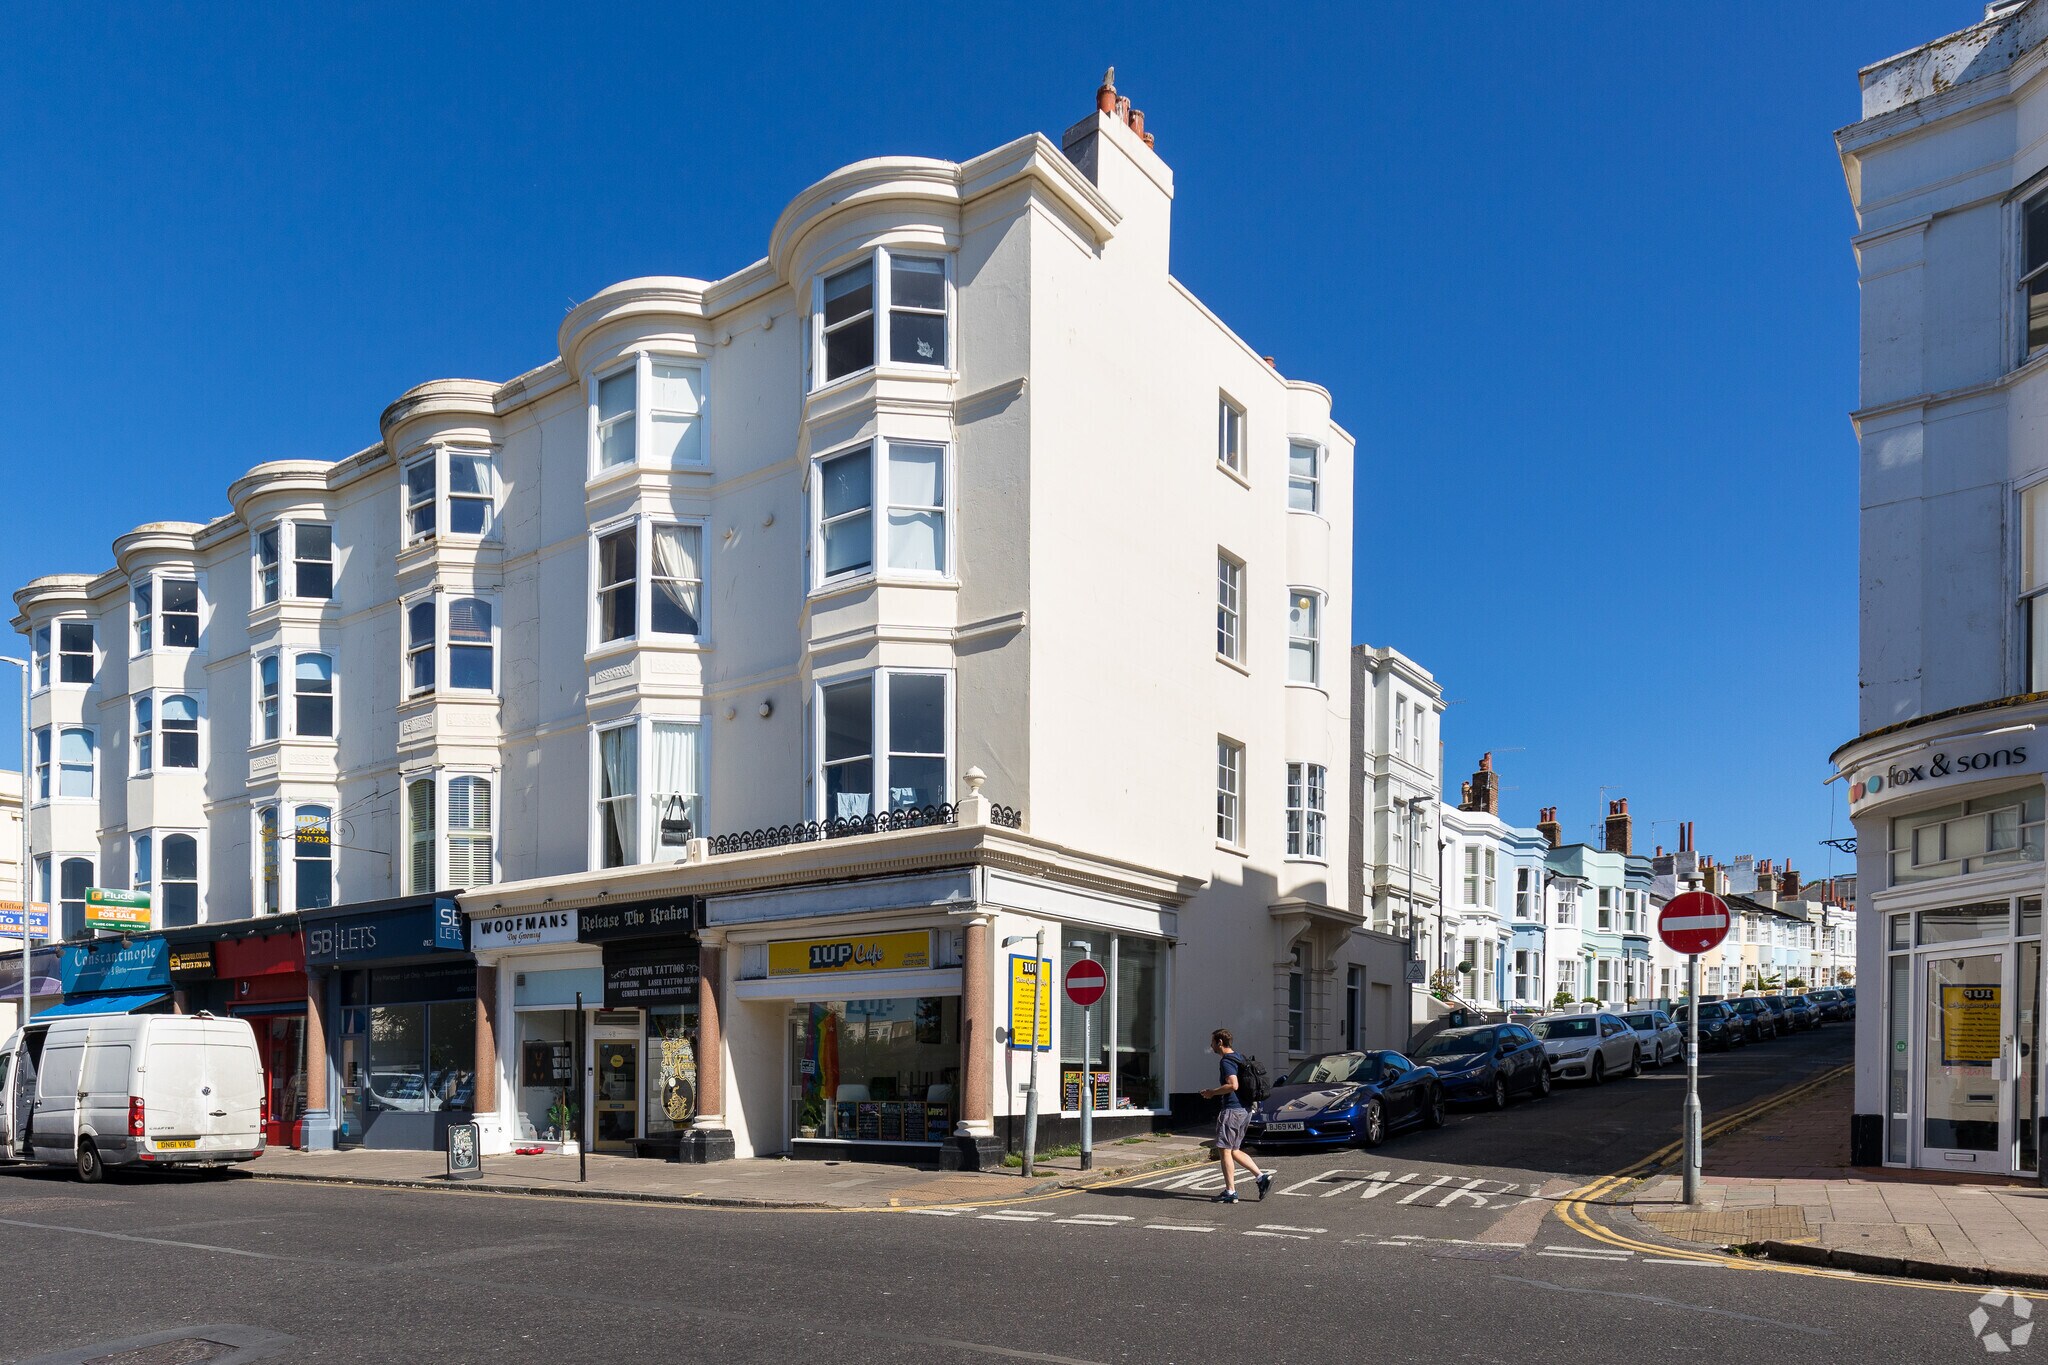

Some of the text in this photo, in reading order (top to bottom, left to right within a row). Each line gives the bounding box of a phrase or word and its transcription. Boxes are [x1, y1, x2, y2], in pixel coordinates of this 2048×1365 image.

[1886, 746, 2027, 789] fox & sons
[0, 915, 14, 924] To
[481, 913, 568, 934] WOOFMANS
[581, 906, 689, 932] Release The Kraken
[310, 925, 376, 954] SB LETS
[439, 927, 463, 941] LETS
[74, 944, 156, 967] Constantinople
[811, 945, 852, 965] 1UP
[854, 943, 884, 967] Cafe
[629, 964, 685, 977] CUSTOM TATTOOS
[620, 980, 640, 989] PIERCING
[648, 979, 663, 987] LASER
[663, 977, 683, 986] TATTOO
[622, 986, 692, 998] GENDER NEUTRAL HAIRSTYLING
[1269, 1122, 1302, 1131] BJ69 KWU
[161, 1141, 177, 1149] DN61
